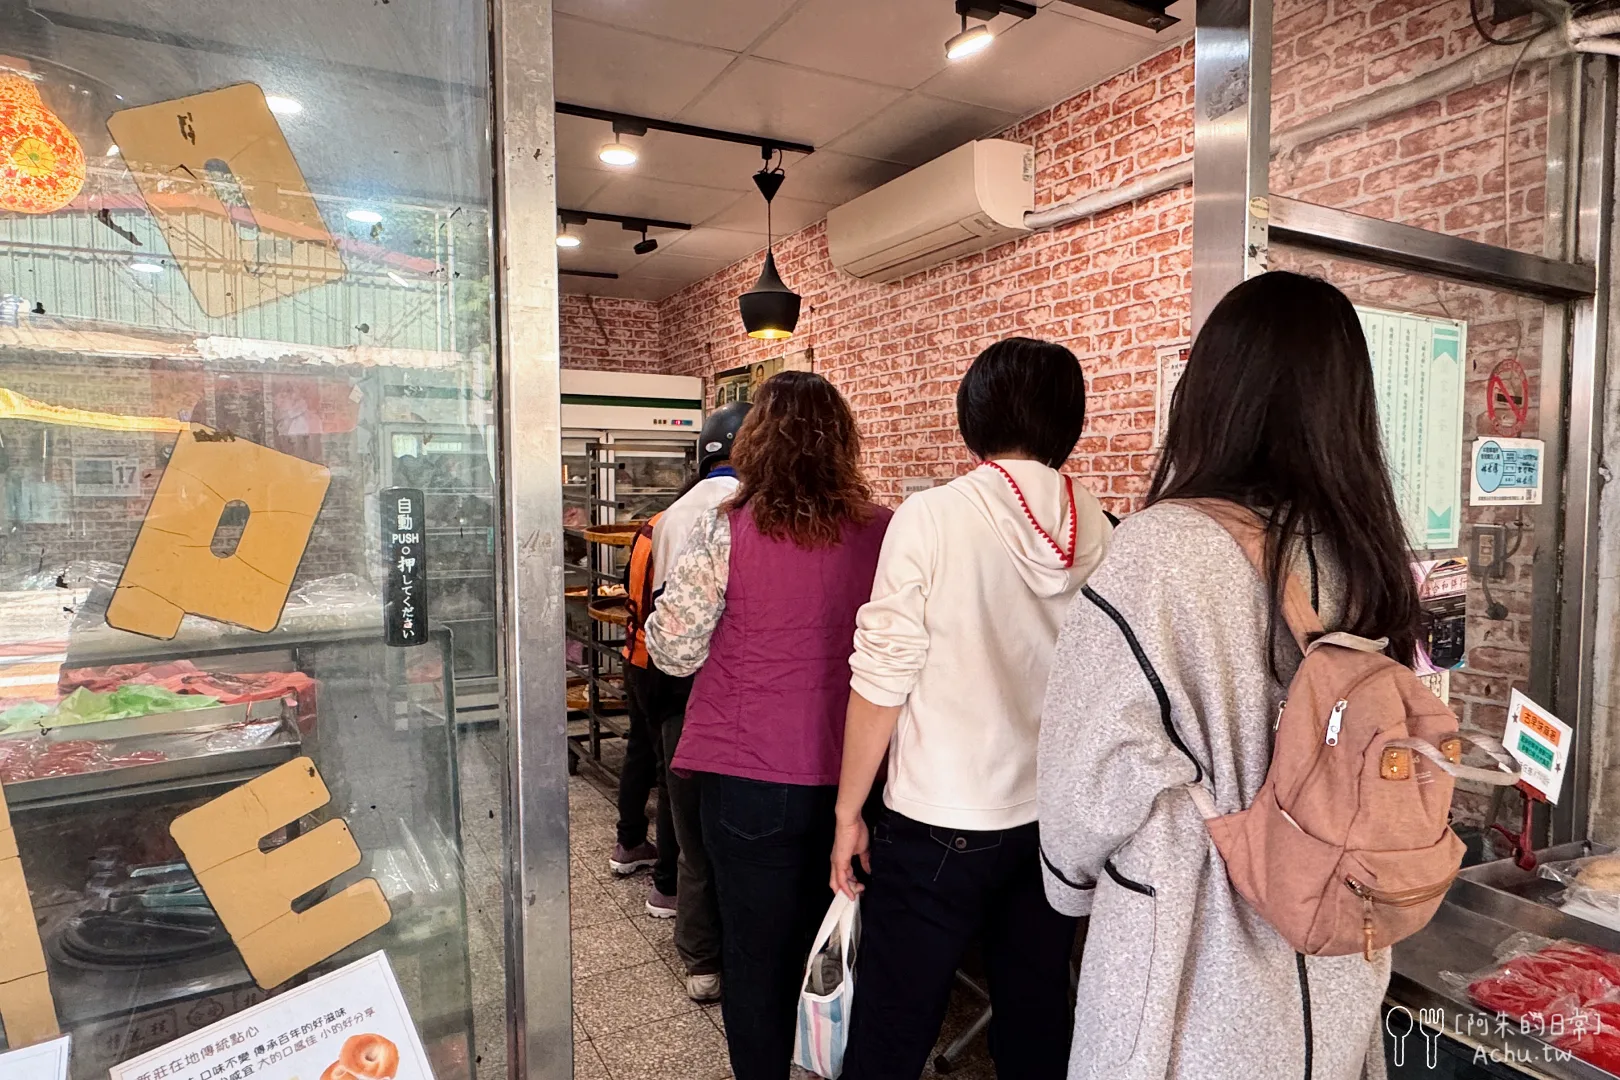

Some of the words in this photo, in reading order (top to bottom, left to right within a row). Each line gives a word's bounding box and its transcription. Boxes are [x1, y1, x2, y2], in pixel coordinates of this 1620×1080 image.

[116, 466, 137, 484] 17
[392, 533, 420, 544] PUSH
[397, 497, 413, 531] 自動
[397, 556, 416, 640] 押してください
[200, 1052, 251, 1080] 口味不變
[253, 1007, 347, 1058] 傳承百年的好滋味
[258, 1034, 318, 1071] 大的口感佳
[320, 1007, 376, 1040] 小的好分享
